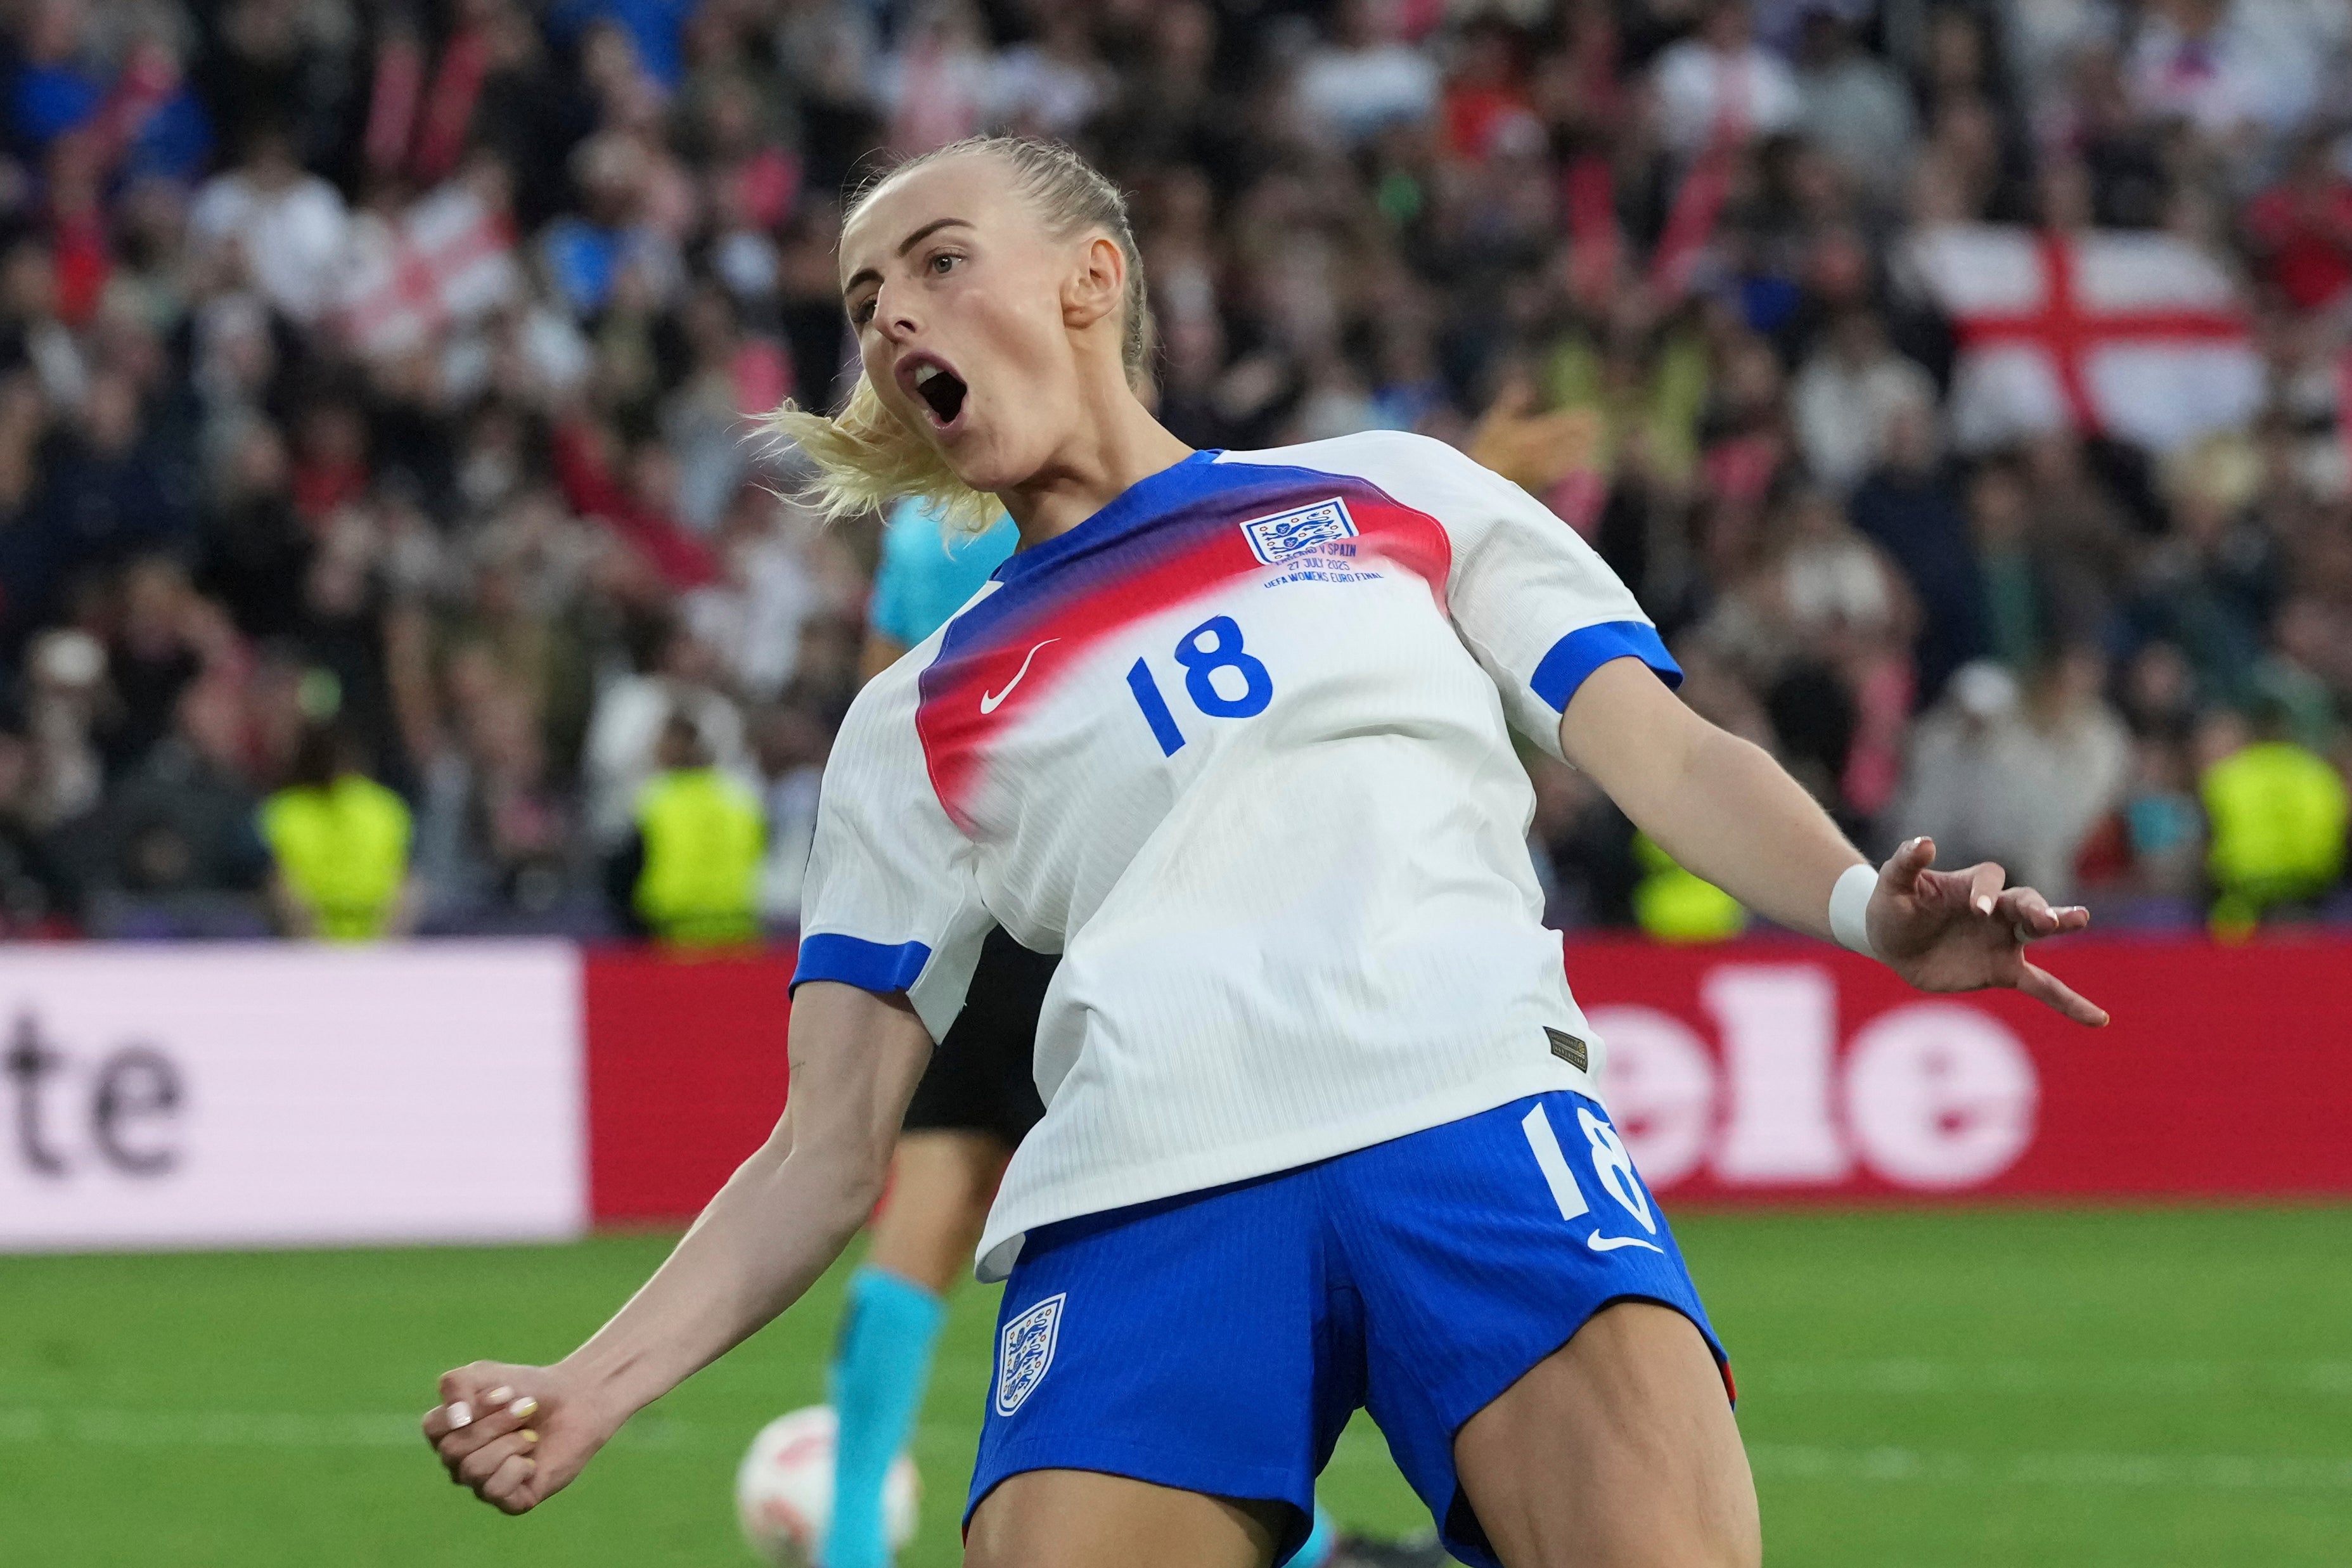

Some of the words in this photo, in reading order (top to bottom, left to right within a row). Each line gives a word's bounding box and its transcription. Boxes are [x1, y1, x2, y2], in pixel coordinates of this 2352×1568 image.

[1319, 544, 1325, 554] V
[1328, 543, 1356, 556] SPAIN
[1287, 561, 1299, 570] 27
[1302, 558, 1324, 568] JULY
[1328, 559, 1350, 570] 2025
[1264, 576, 1288, 588] UEFA
[1288, 572, 1328, 582] WOMENS
[1330, 572, 1354, 582] EURO
[1355, 572, 1384, 581] FINAL
[1126, 613, 1273, 758] 18
[1521, 1102, 1656, 1235] 18
